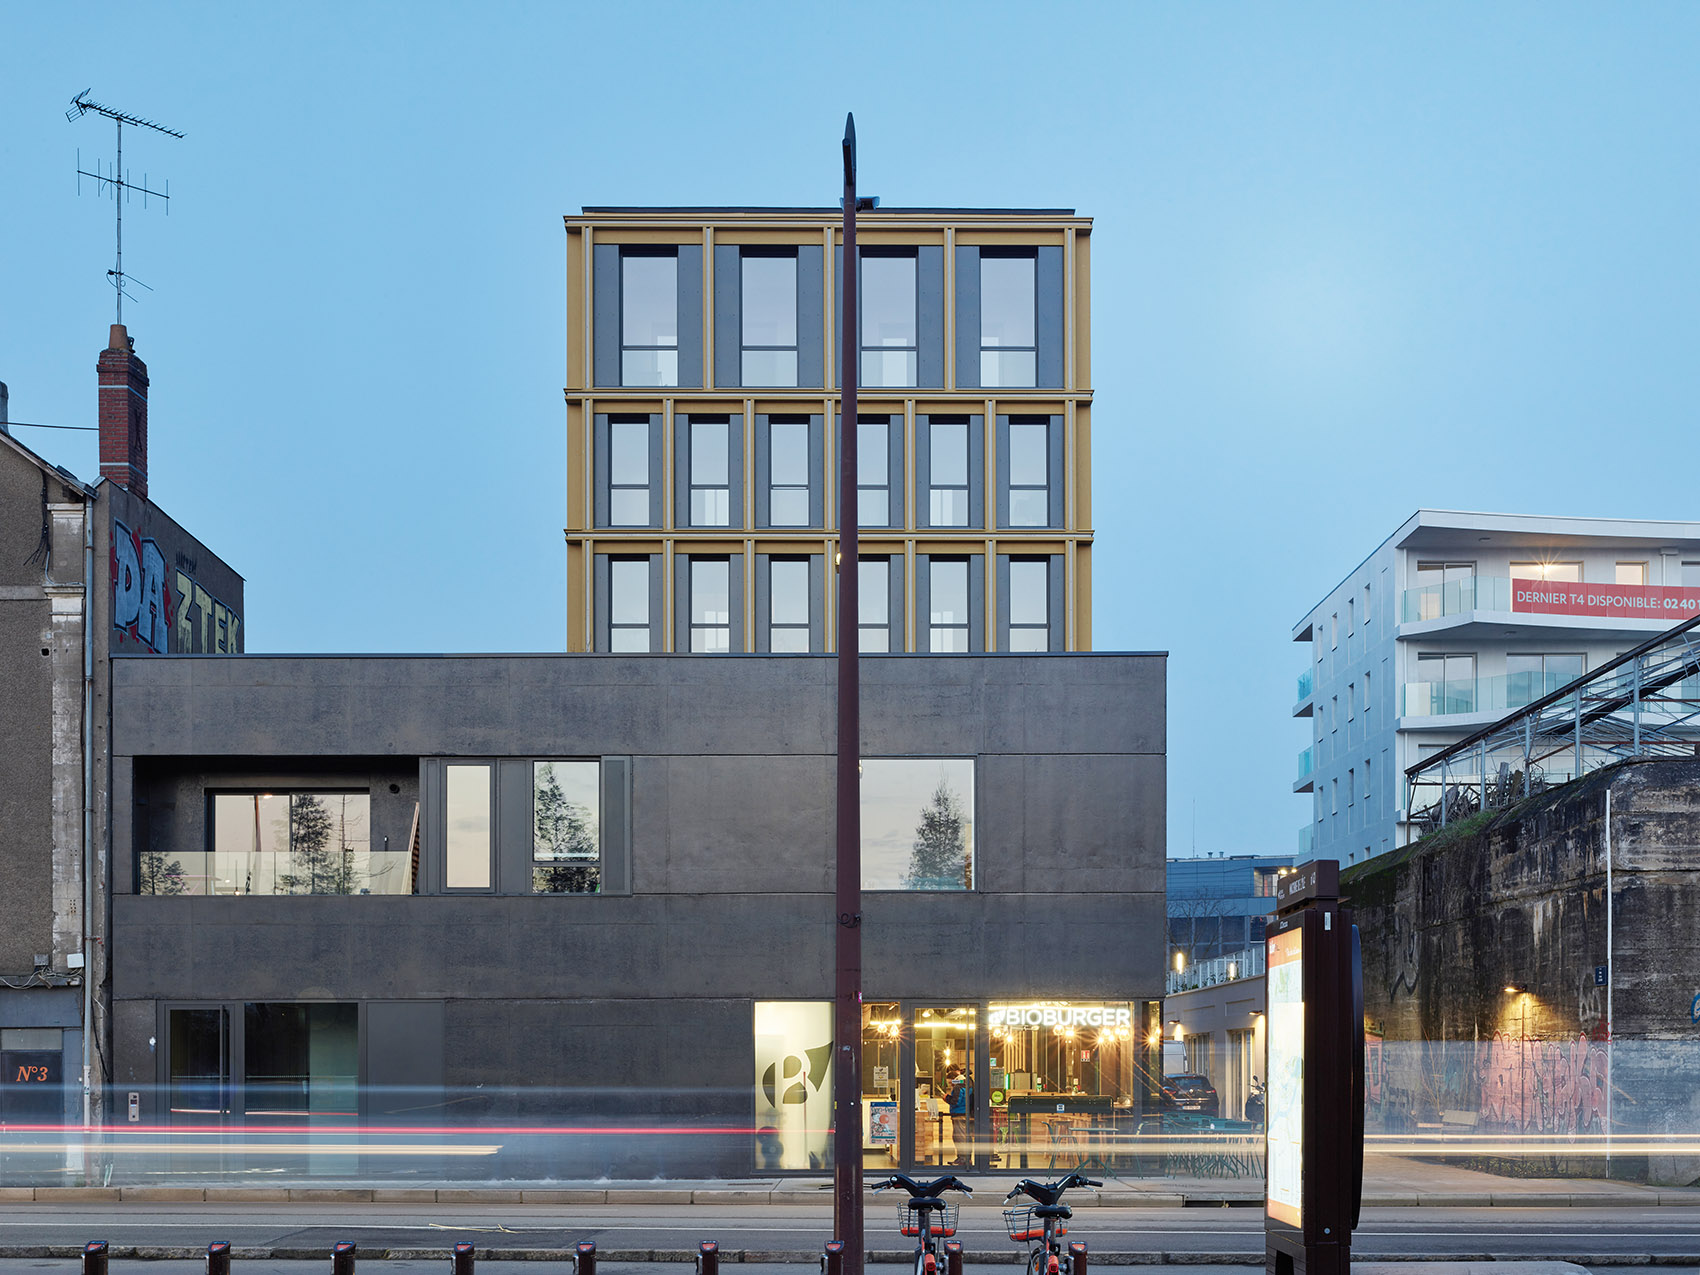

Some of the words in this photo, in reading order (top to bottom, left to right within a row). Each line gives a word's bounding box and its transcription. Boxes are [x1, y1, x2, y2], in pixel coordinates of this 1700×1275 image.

[1517, 590, 1567, 605] DERNIER
[1569, 593, 1585, 605] T4
[1587, 594, 1661, 609] DISPONIBLE:
[1006, 1008, 1130, 1027] BIOBURGER
[16, 1065, 48, 1082] N°3
